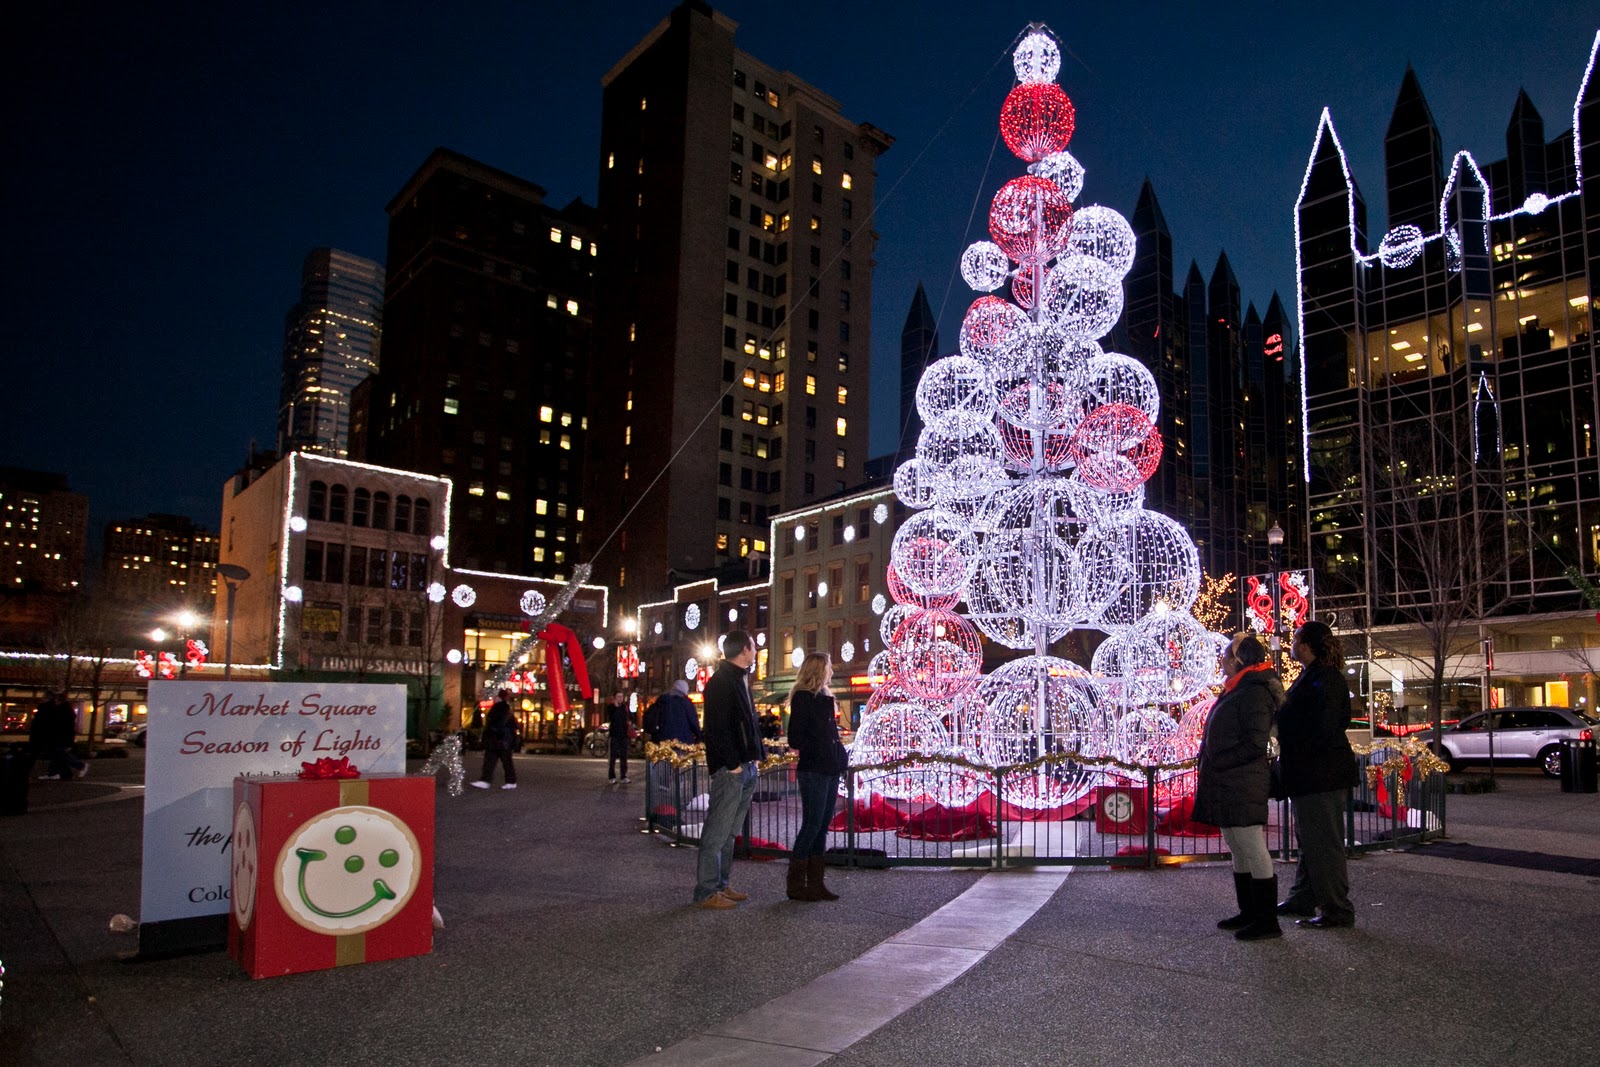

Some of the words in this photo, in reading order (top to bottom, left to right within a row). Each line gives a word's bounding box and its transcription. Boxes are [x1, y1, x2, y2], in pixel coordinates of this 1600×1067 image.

[484, 679, 547, 691] SARKS
[186, 692, 290, 717] Market
[298, 693, 377, 722] Square
[179, 730, 270, 755] Season
[279, 730, 307, 757] of
[312, 729, 381, 757] Lights
[184, 825, 226, 848] the
